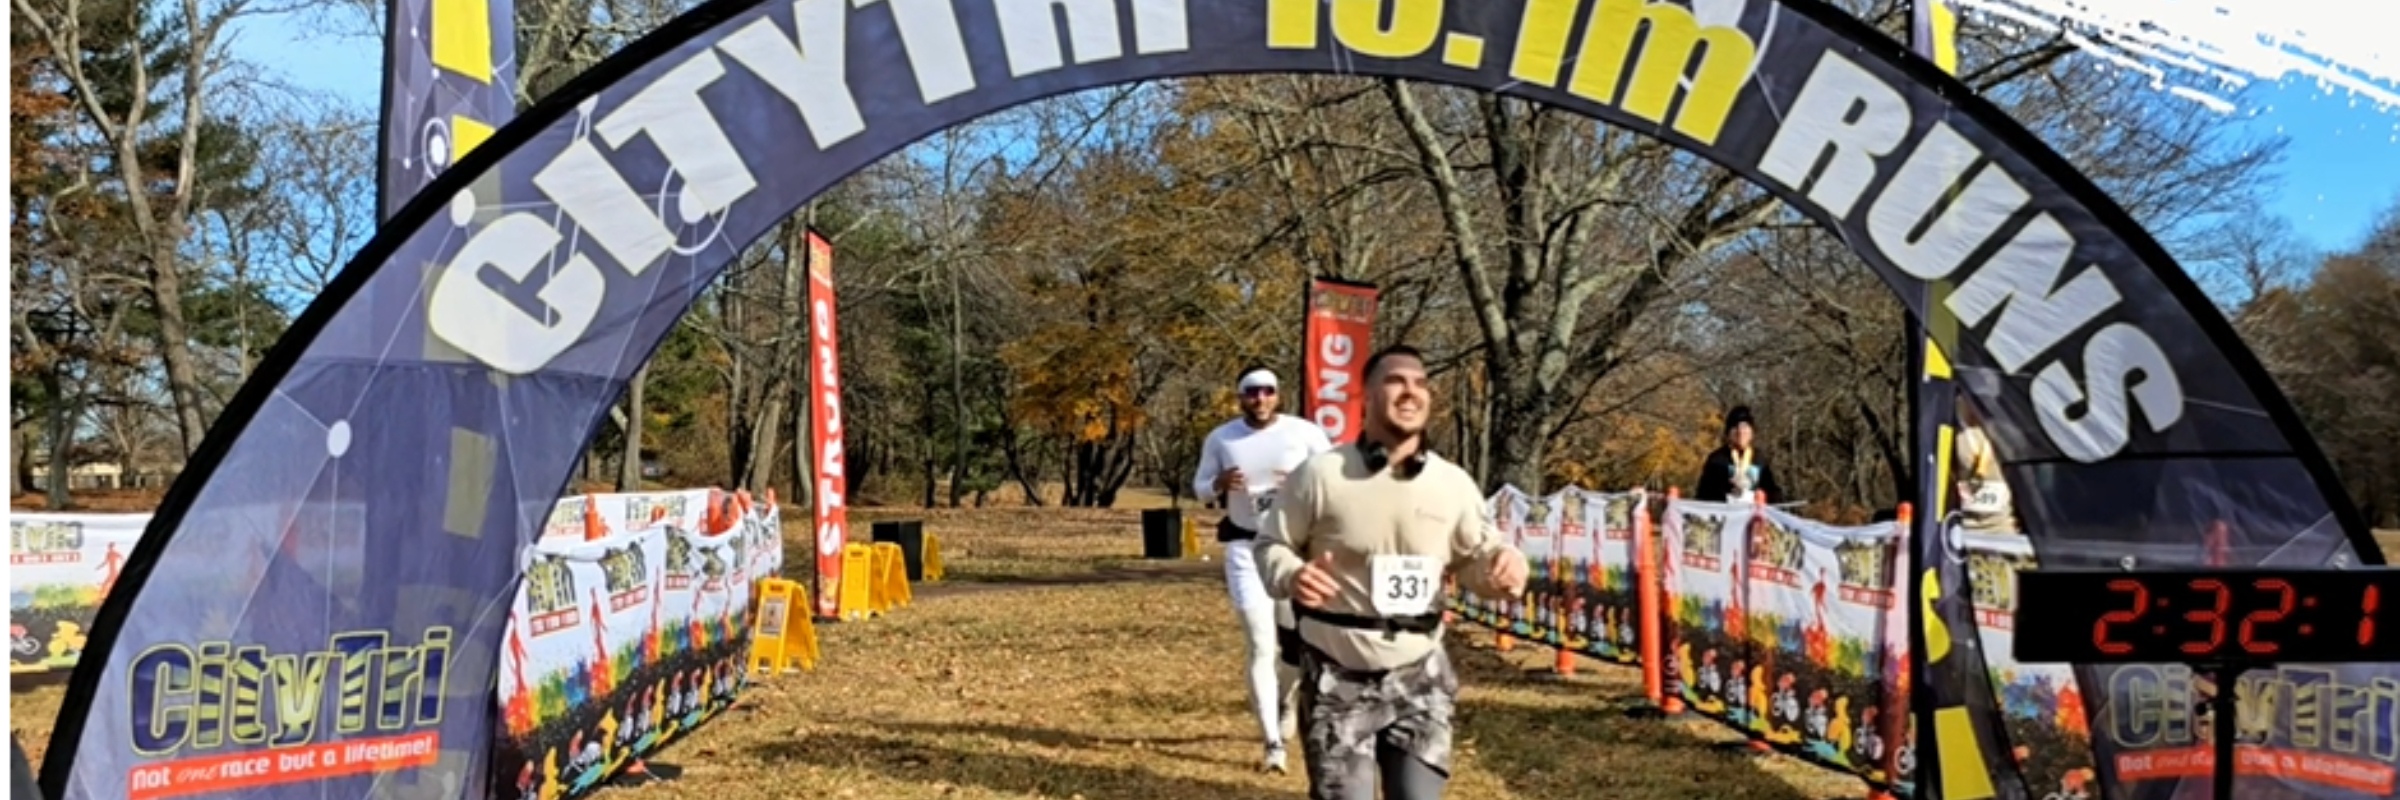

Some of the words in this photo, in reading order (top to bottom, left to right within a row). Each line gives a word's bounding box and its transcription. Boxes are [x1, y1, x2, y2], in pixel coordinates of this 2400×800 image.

[1757, 48, 2184, 463] RUNS
[815, 300, 844, 557] STRONG
[1314, 333, 1355, 440] ONG
[1387, 574, 1429, 599] 331
[2093, 579, 2379, 654] 2:32:1
[127, 626, 452, 757] CityTri
[220, 756, 271, 778] race
[278, 750, 316, 772] but
[322, 750, 337, 766] a
[344, 736, 433, 764] lifetime!
